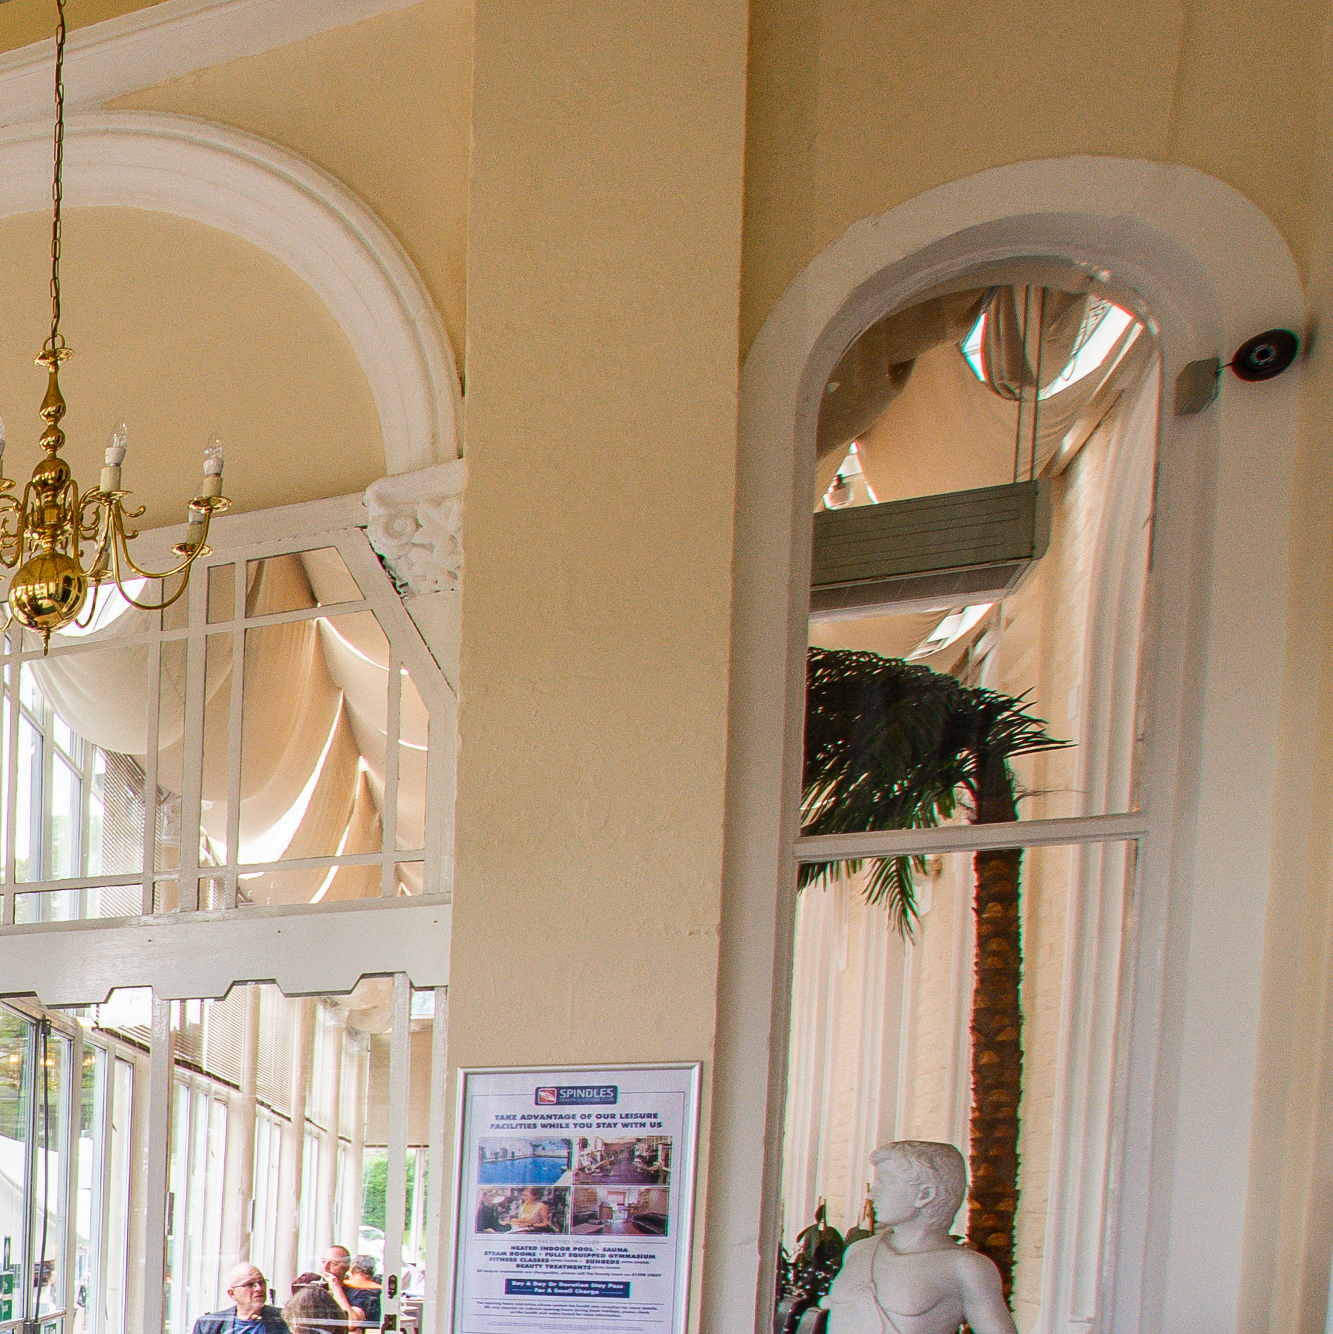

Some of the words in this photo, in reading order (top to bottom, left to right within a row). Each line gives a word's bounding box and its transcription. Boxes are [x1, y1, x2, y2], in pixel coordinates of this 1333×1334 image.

[559, 1088, 615, 1098] SPINDLES
[619, 1112, 659, 1120] LEISURE
[490, 1122, 537, 1130] FACILITIES
[591, 1282, 606, 1290] Stay
